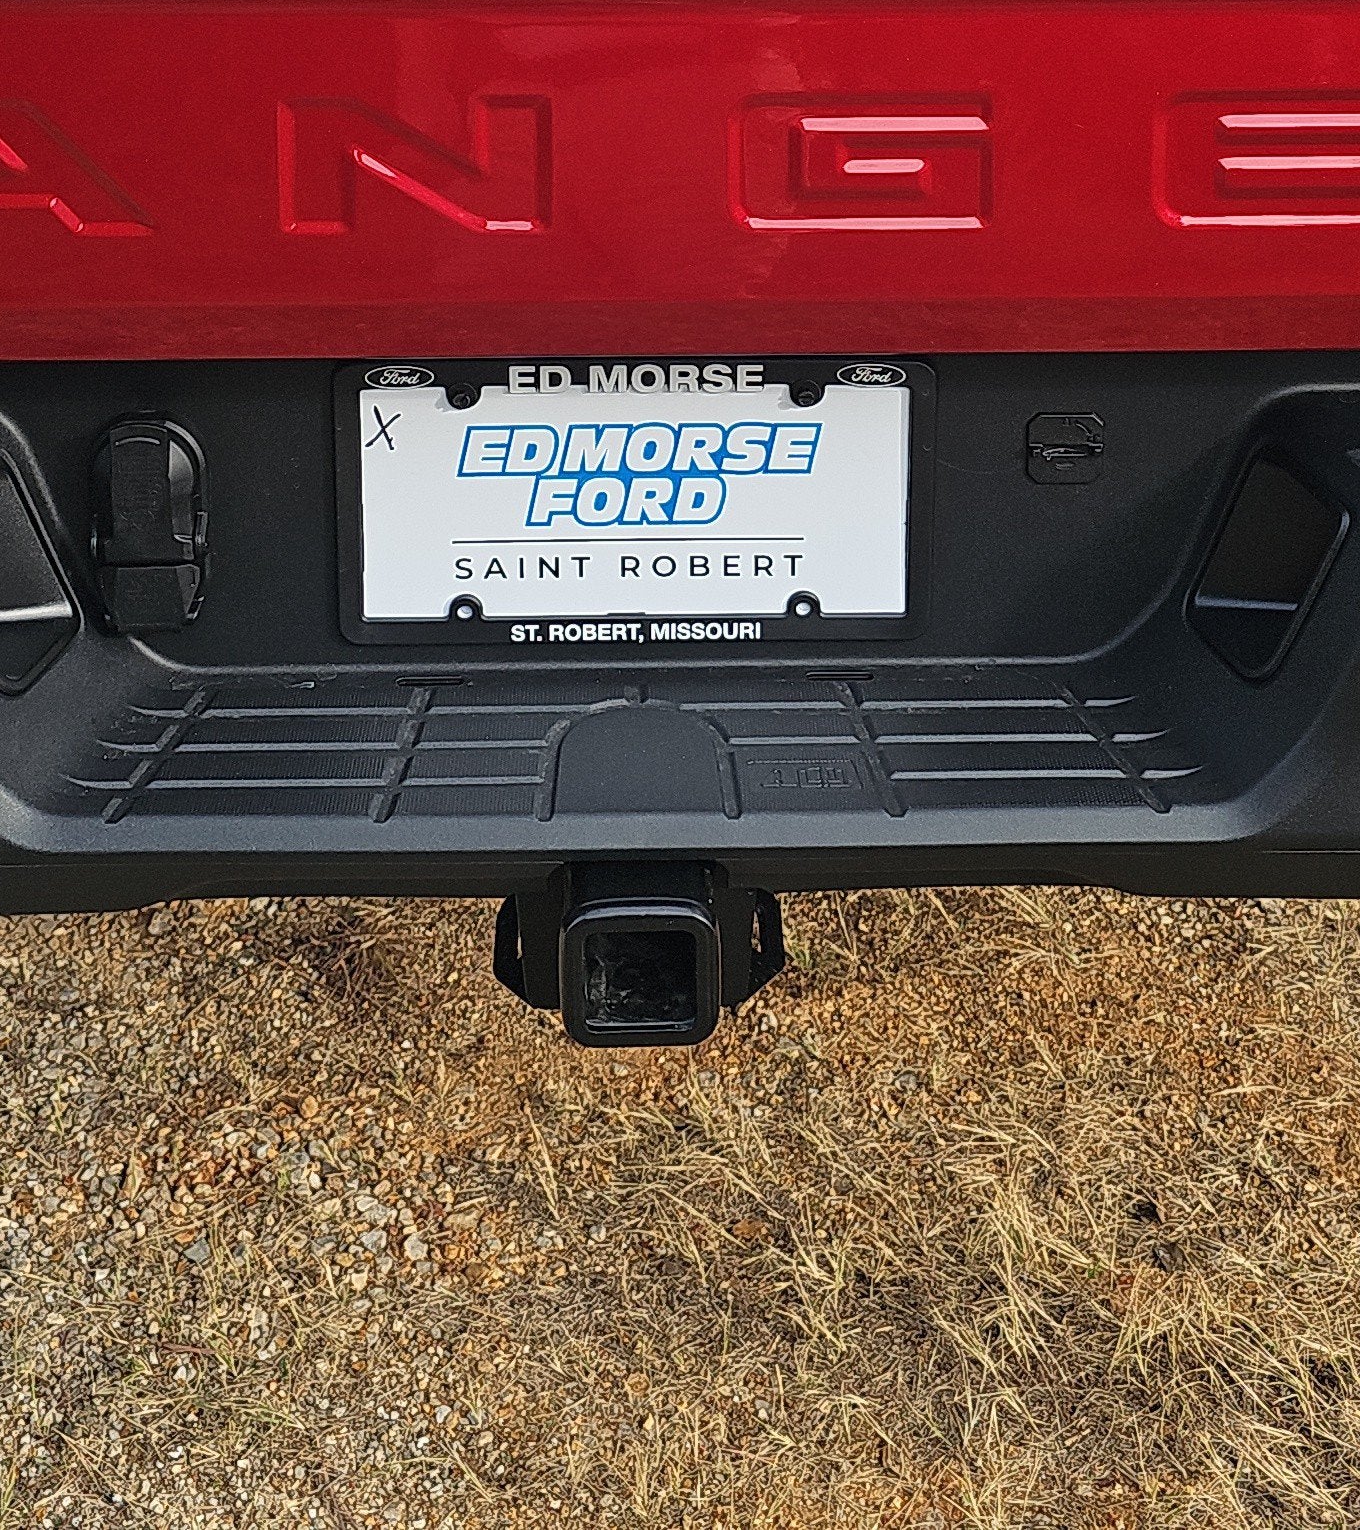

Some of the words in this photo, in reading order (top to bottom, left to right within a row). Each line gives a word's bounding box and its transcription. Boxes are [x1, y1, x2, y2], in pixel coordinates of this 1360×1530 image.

[379, 369, 420, 385] Ford
[508, 364, 572, 394] ED
[589, 363, 765, 393] MORSE
[851, 367, 892, 383] Ford
[457, 424, 560, 477] ED
[558, 422, 823, 474] MORSE
[525, 474, 727, 526] FORD
[455, 556, 591, 580] SAINT
[620, 554, 803, 577] ROBERT
[510, 624, 543, 642] ST.
[549, 623, 644, 643] ROBERT,
[650, 622, 761, 641] MISSOURI
